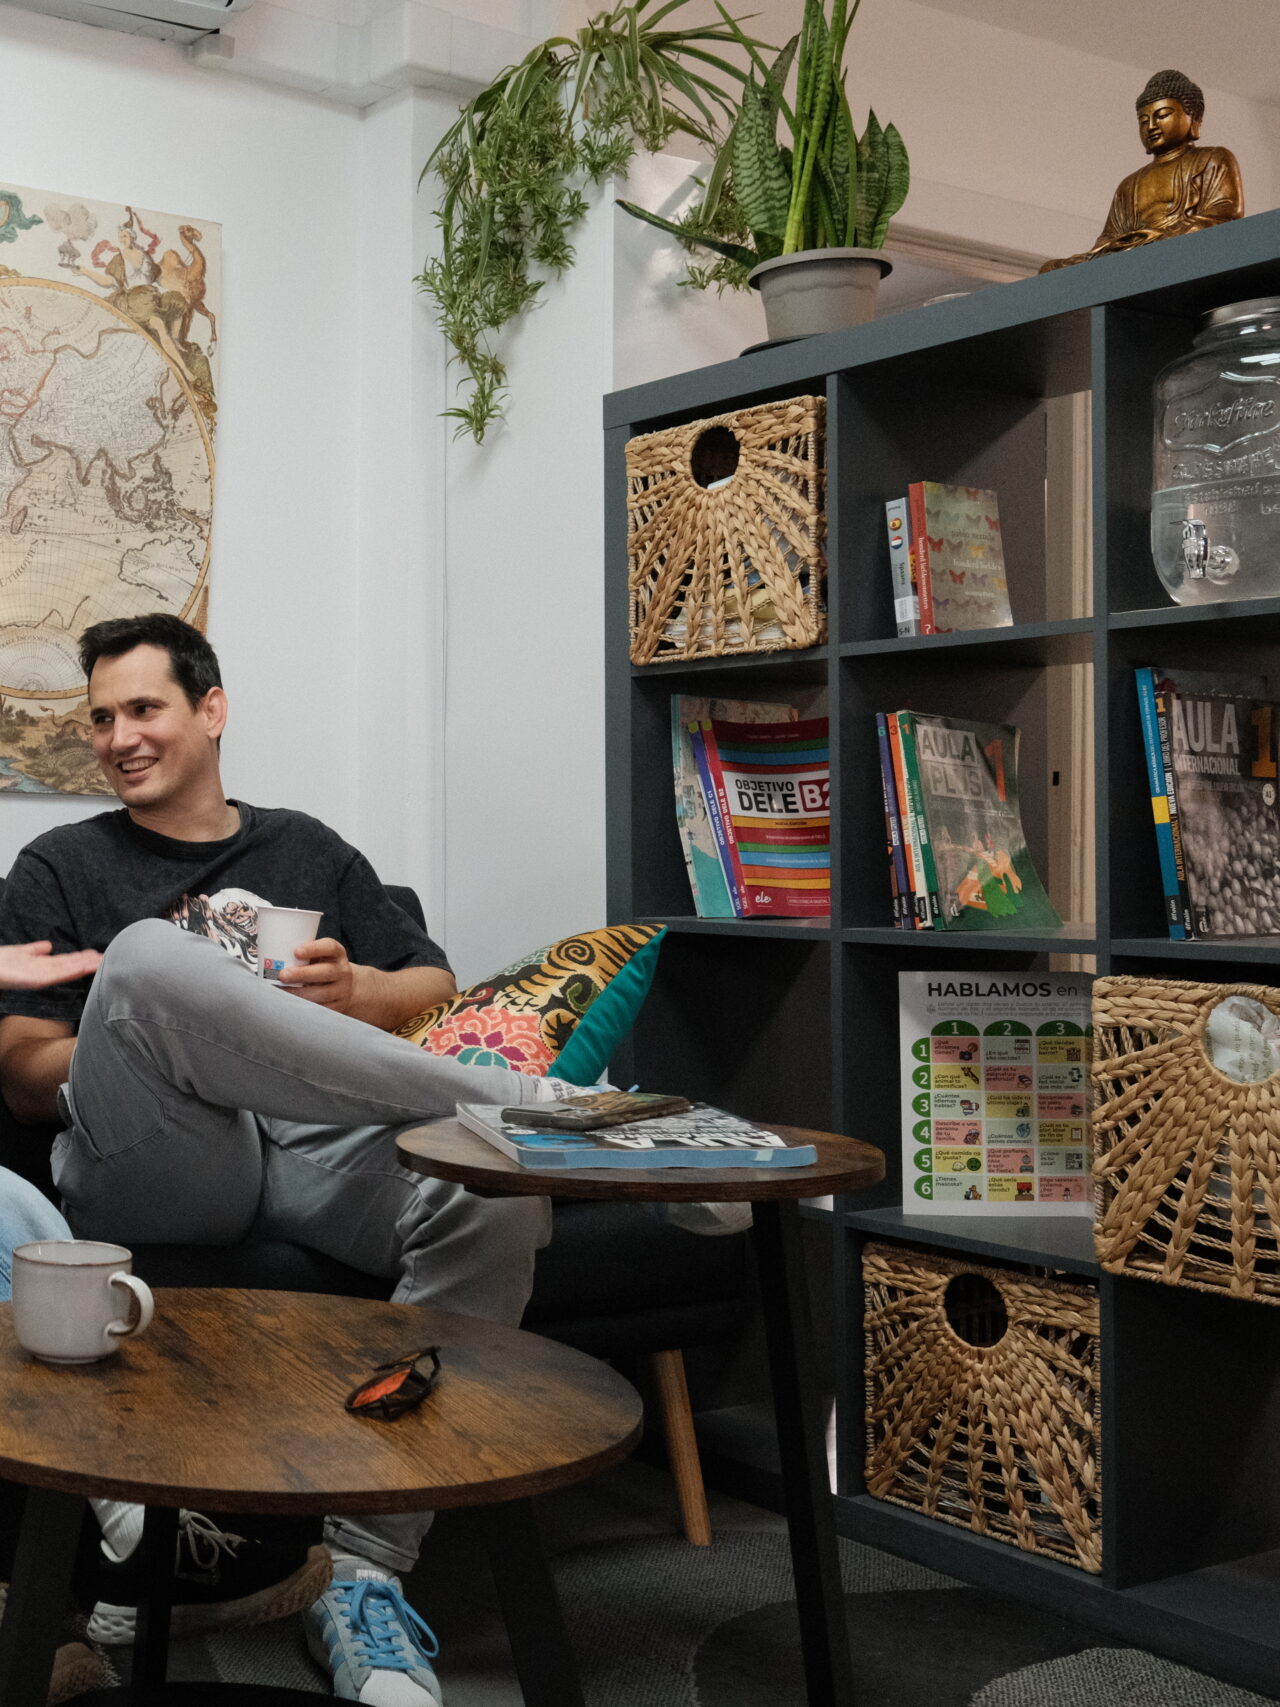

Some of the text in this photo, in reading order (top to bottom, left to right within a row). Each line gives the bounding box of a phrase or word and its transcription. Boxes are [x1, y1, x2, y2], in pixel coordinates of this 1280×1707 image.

[1156, 697, 1166, 712] 1
[877, 725, 886, 737] 6
[889, 725, 898, 736] 3
[902, 723, 911, 736] 1
[1172, 699, 1240, 755] AULA
[922, 734, 976, 762] AULA
[1250, 706, 1277, 778] 1
[984, 739, 1007, 802] 1
[735, 778, 795, 793] OBJETIVO
[709, 800, 718, 815] DELE
[738, 791, 799, 813] DELE
[1169, 794, 1177, 815] NUEVA
[1172, 819, 1183, 863] INTERNACIONAL
[1177, 862, 1185, 881] AULA
[927, 982, 1078, 997] HABLAMOS en
[951, 1022, 1065, 1036] 1 2 3
[919, 1044, 927, 1057] 1
[919, 1072, 928, 1085] 2
[920, 1099, 929, 1112] 3
[920, 1126, 930, 1139] 4
[921, 1154, 930, 1168] 5
[921, 1182, 931, 1195] 6
